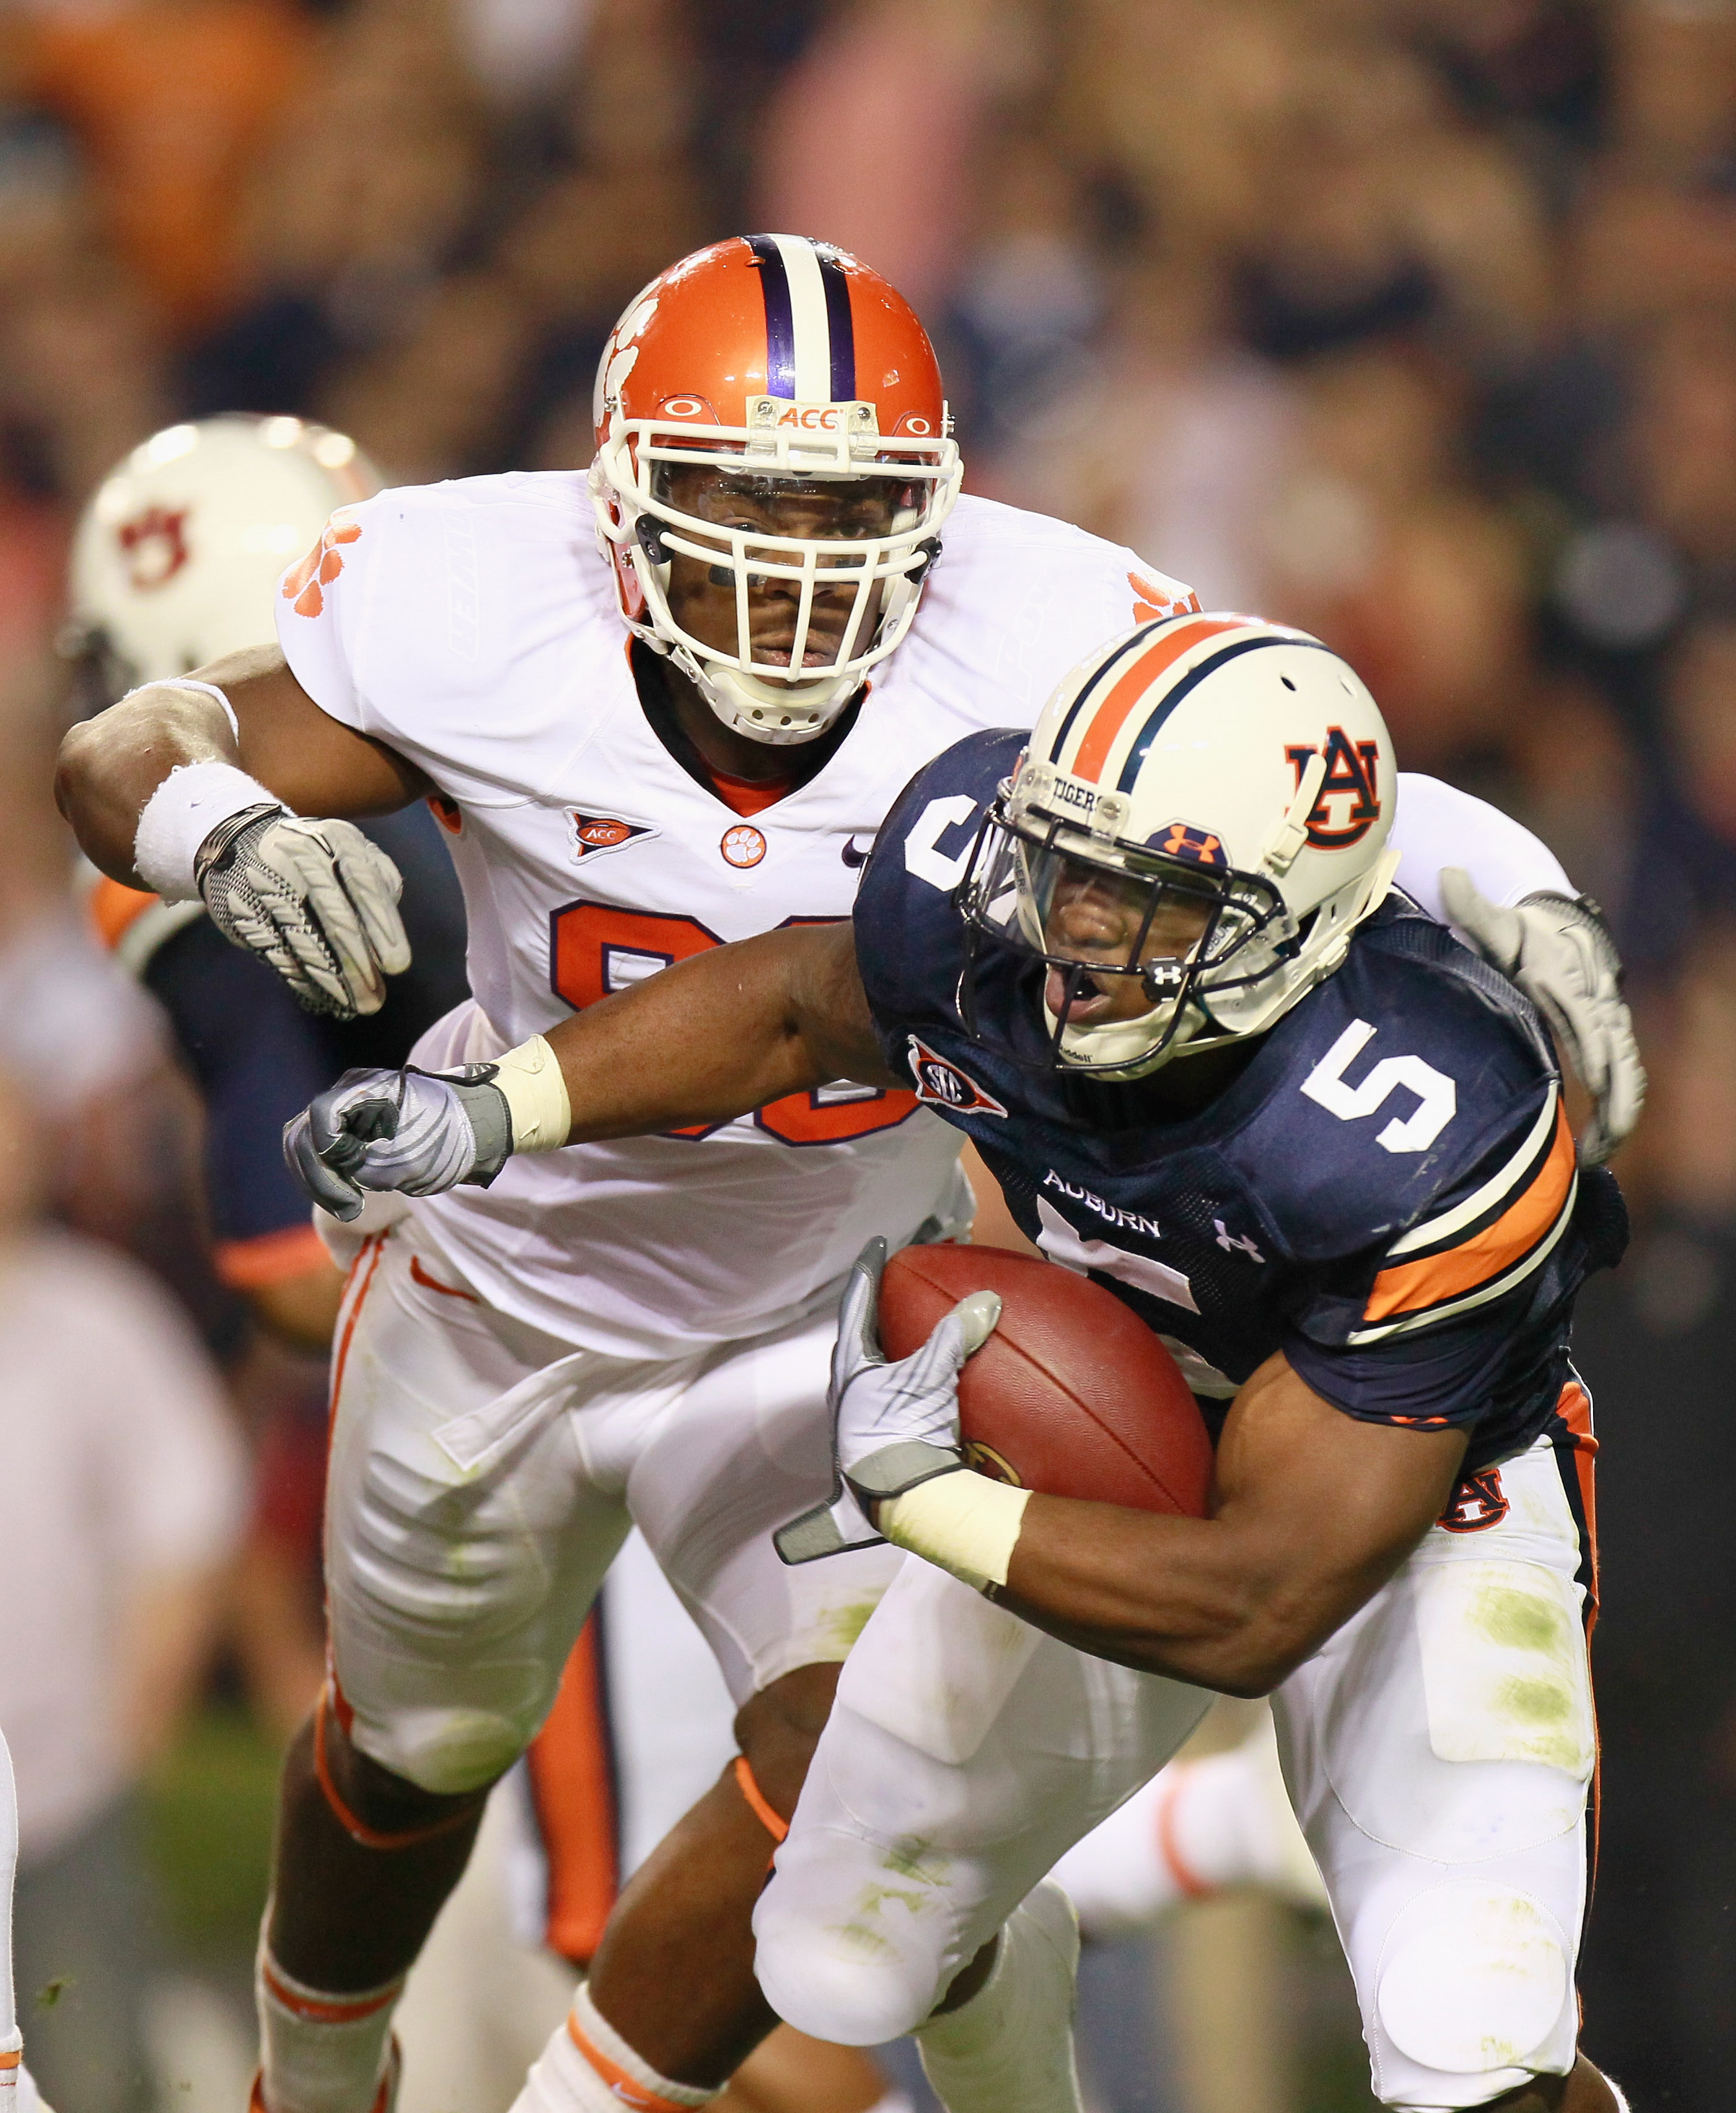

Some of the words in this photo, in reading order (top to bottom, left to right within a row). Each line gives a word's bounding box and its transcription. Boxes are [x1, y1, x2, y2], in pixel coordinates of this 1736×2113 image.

[777, 408, 838, 429] ACC
[586, 829, 616, 840] ACC
[927, 1064, 963, 1102] SEC
[1299, 1018, 1456, 1154] 5
[1043, 1168, 1161, 1238] AUBURN
